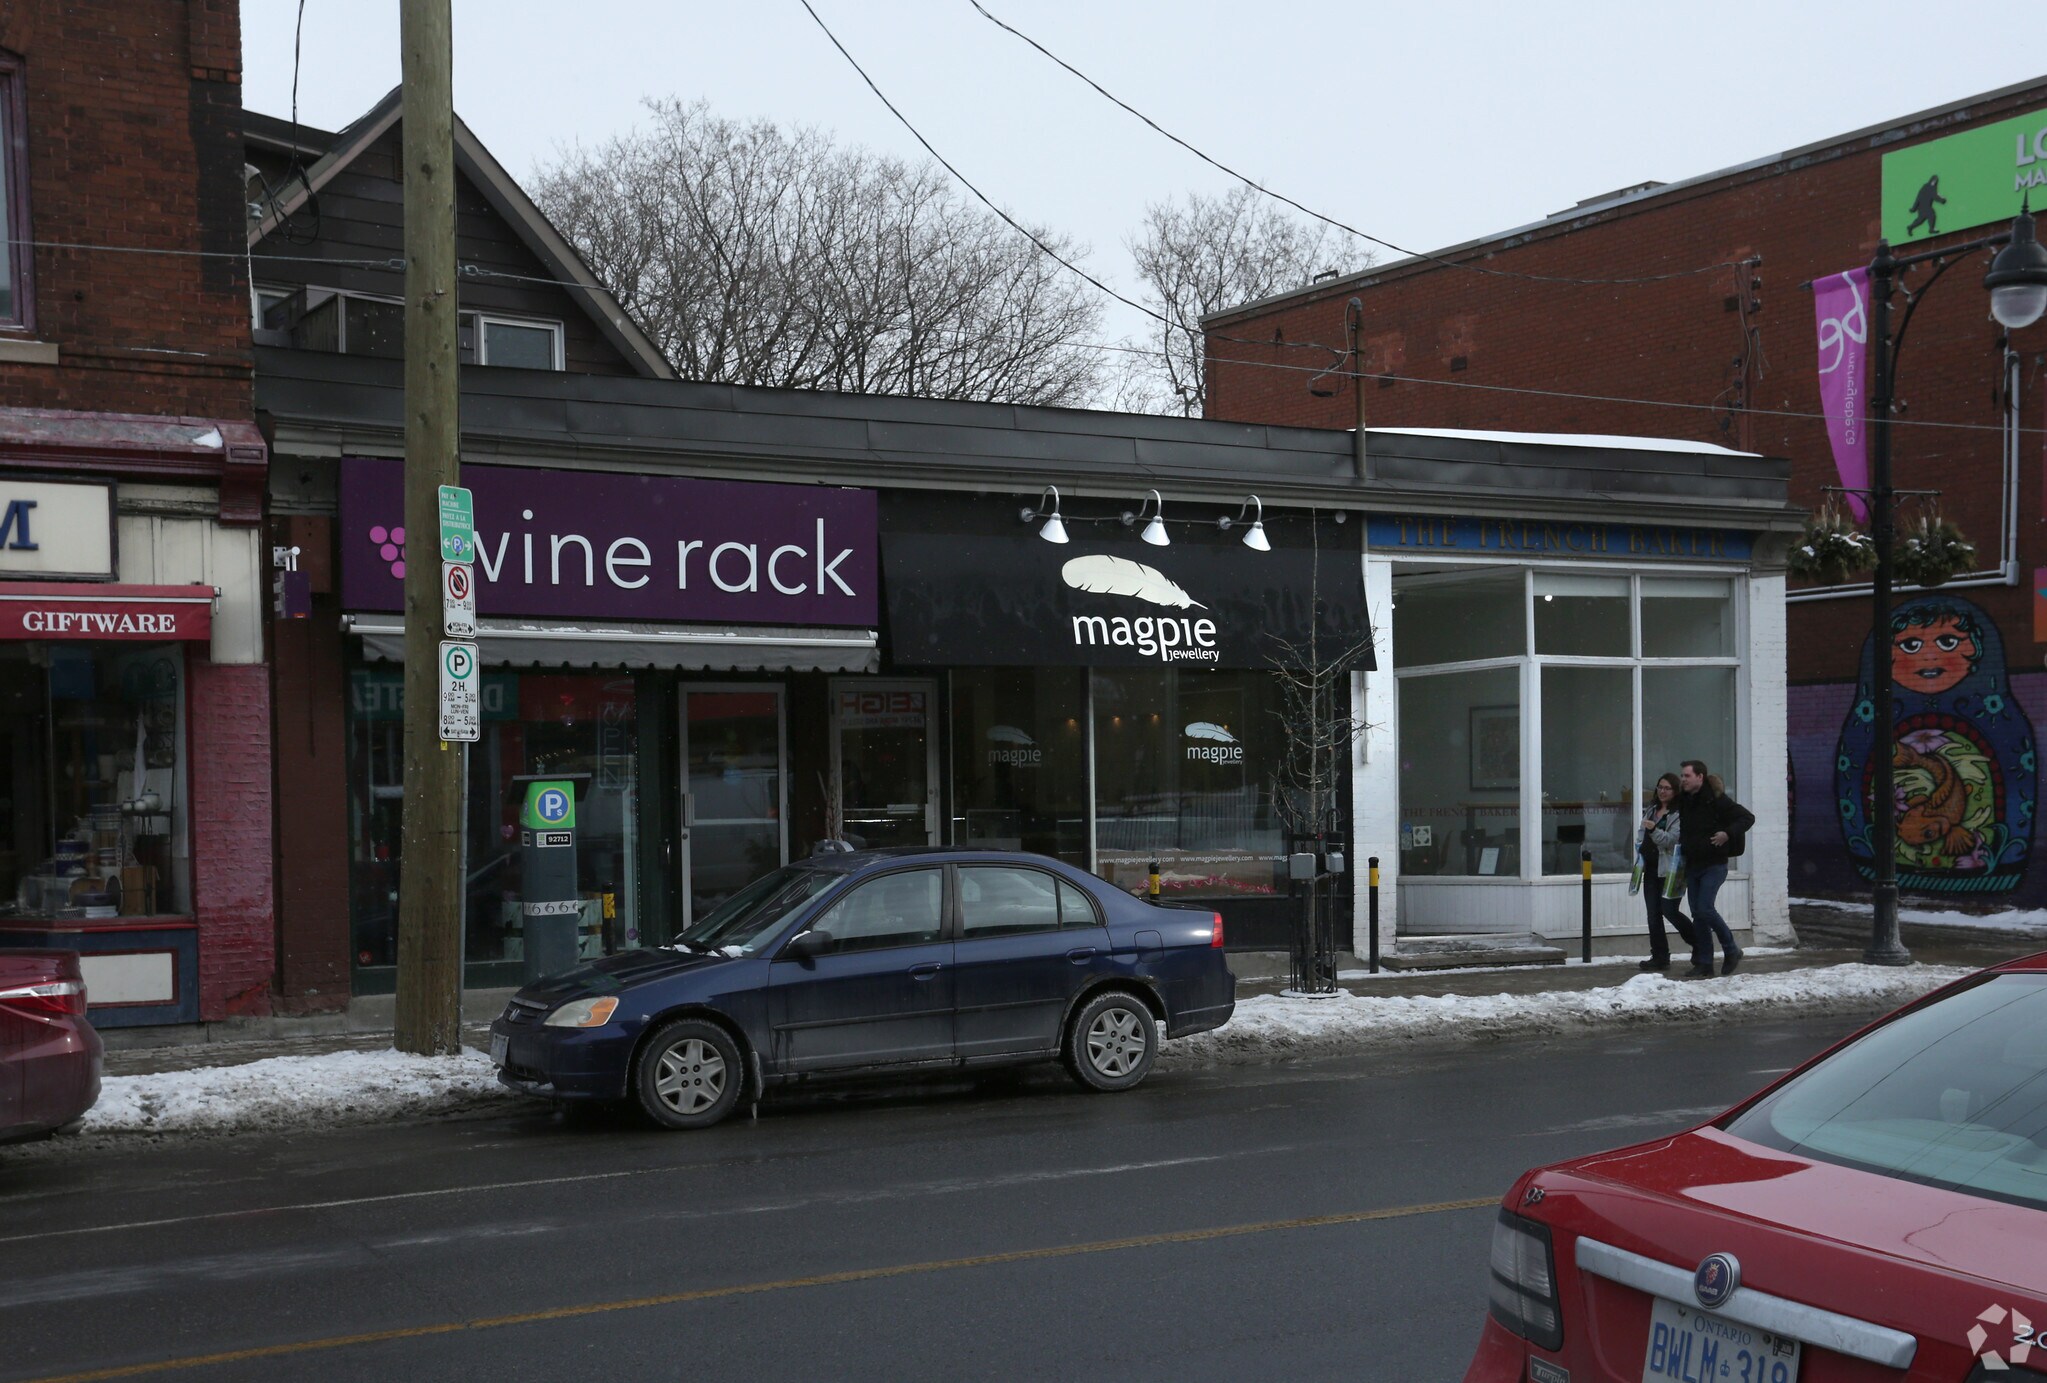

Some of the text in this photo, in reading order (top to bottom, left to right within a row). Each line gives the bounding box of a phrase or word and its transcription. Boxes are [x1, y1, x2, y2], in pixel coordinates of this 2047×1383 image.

[1395, 516, 1726, 557] THE FRENCH BAKER
[678, 517, 857, 597] rack
[22, 610, 176, 634] GIFTWARE
[1072, 615, 1217, 662] magpie
[454, 654, 465, 672] P
[1168, 648, 1220, 662] jewellery
[988, 749, 1042, 768] magpie
[1187, 746, 1243, 765] magpie
[1099, 856, 1175, 864] www.magpiejewellery.com
[1180, 854, 1254, 863] www.magpiejewellery.com
[1694, 1315, 1752, 1346] ONTARIO
[1650, 1322, 1719, 1383] BWLM
